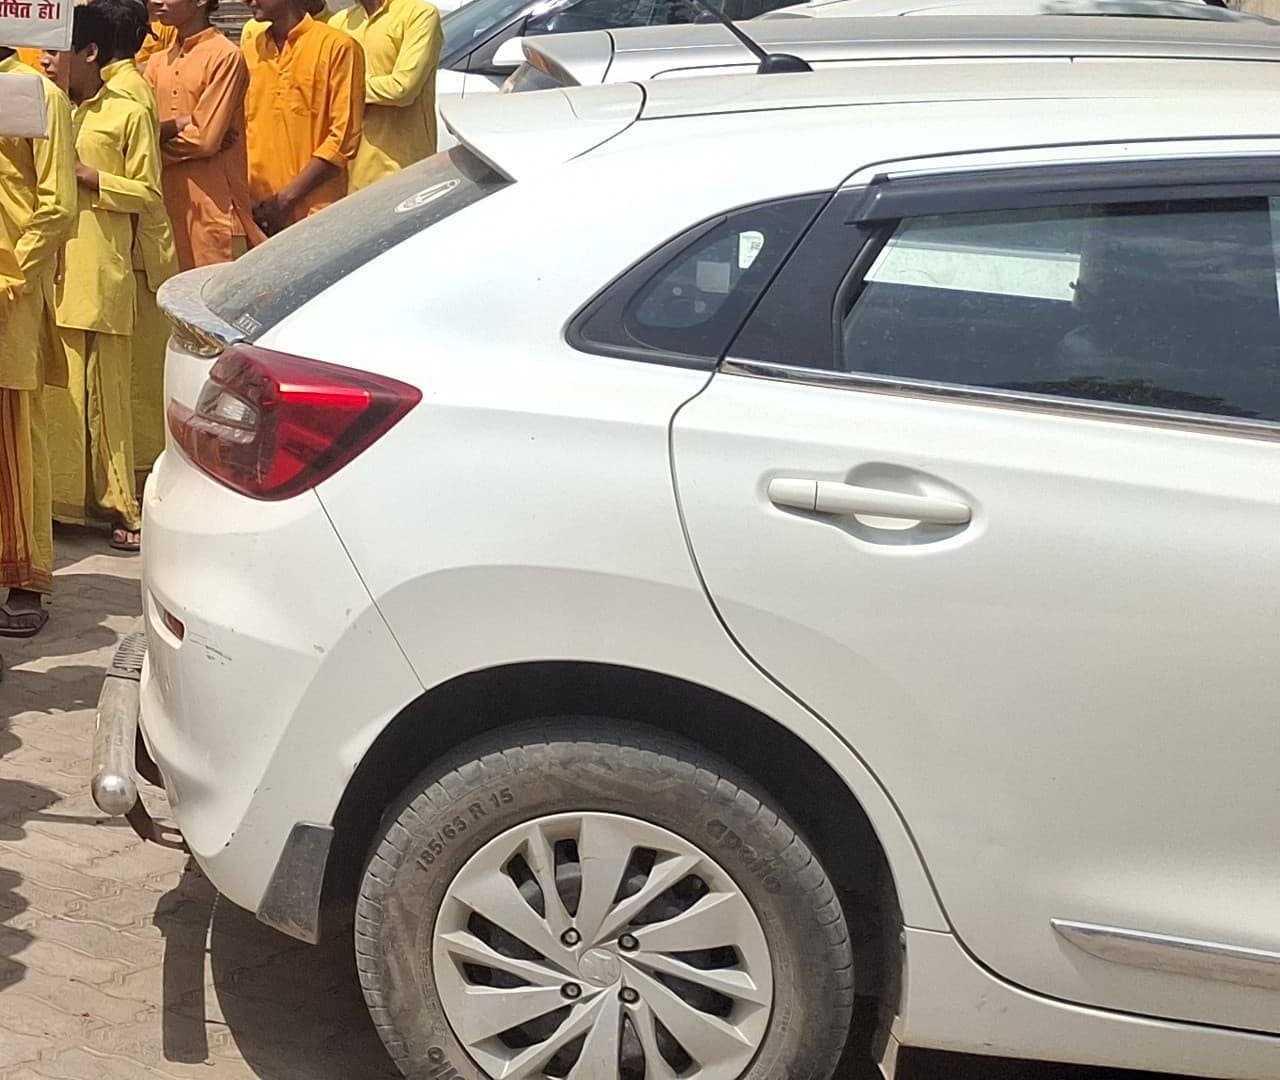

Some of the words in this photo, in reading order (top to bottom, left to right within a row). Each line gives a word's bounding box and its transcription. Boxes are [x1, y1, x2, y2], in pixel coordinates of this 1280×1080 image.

[38, 0, 61, 20] हो।
[467, 802, 488, 820] R
[488, 787, 514, 808] 15
